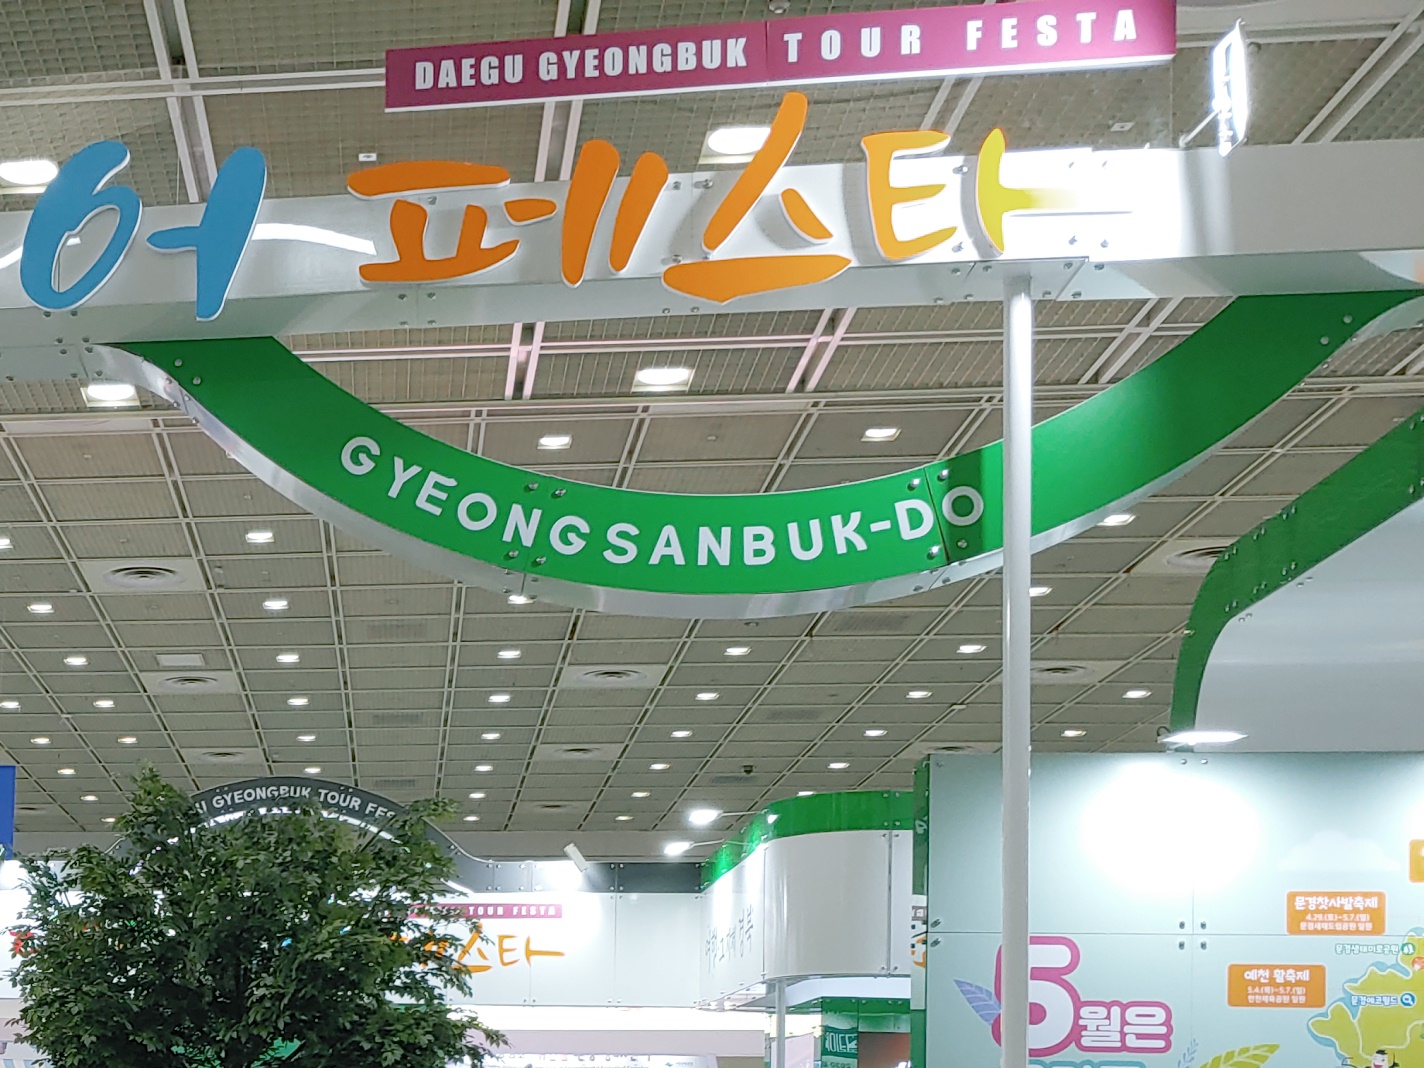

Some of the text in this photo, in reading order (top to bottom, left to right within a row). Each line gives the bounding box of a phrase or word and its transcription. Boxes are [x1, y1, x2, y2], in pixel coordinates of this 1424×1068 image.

[414, 9, 1138, 90] DAEGU GYEONGBUK TOUR FESTA
[341, 436, 985, 567] GYEONGSANBUK-DO
[318, 788, 362, 811] TOUR
[1243, 968, 1270, 984] 예천
